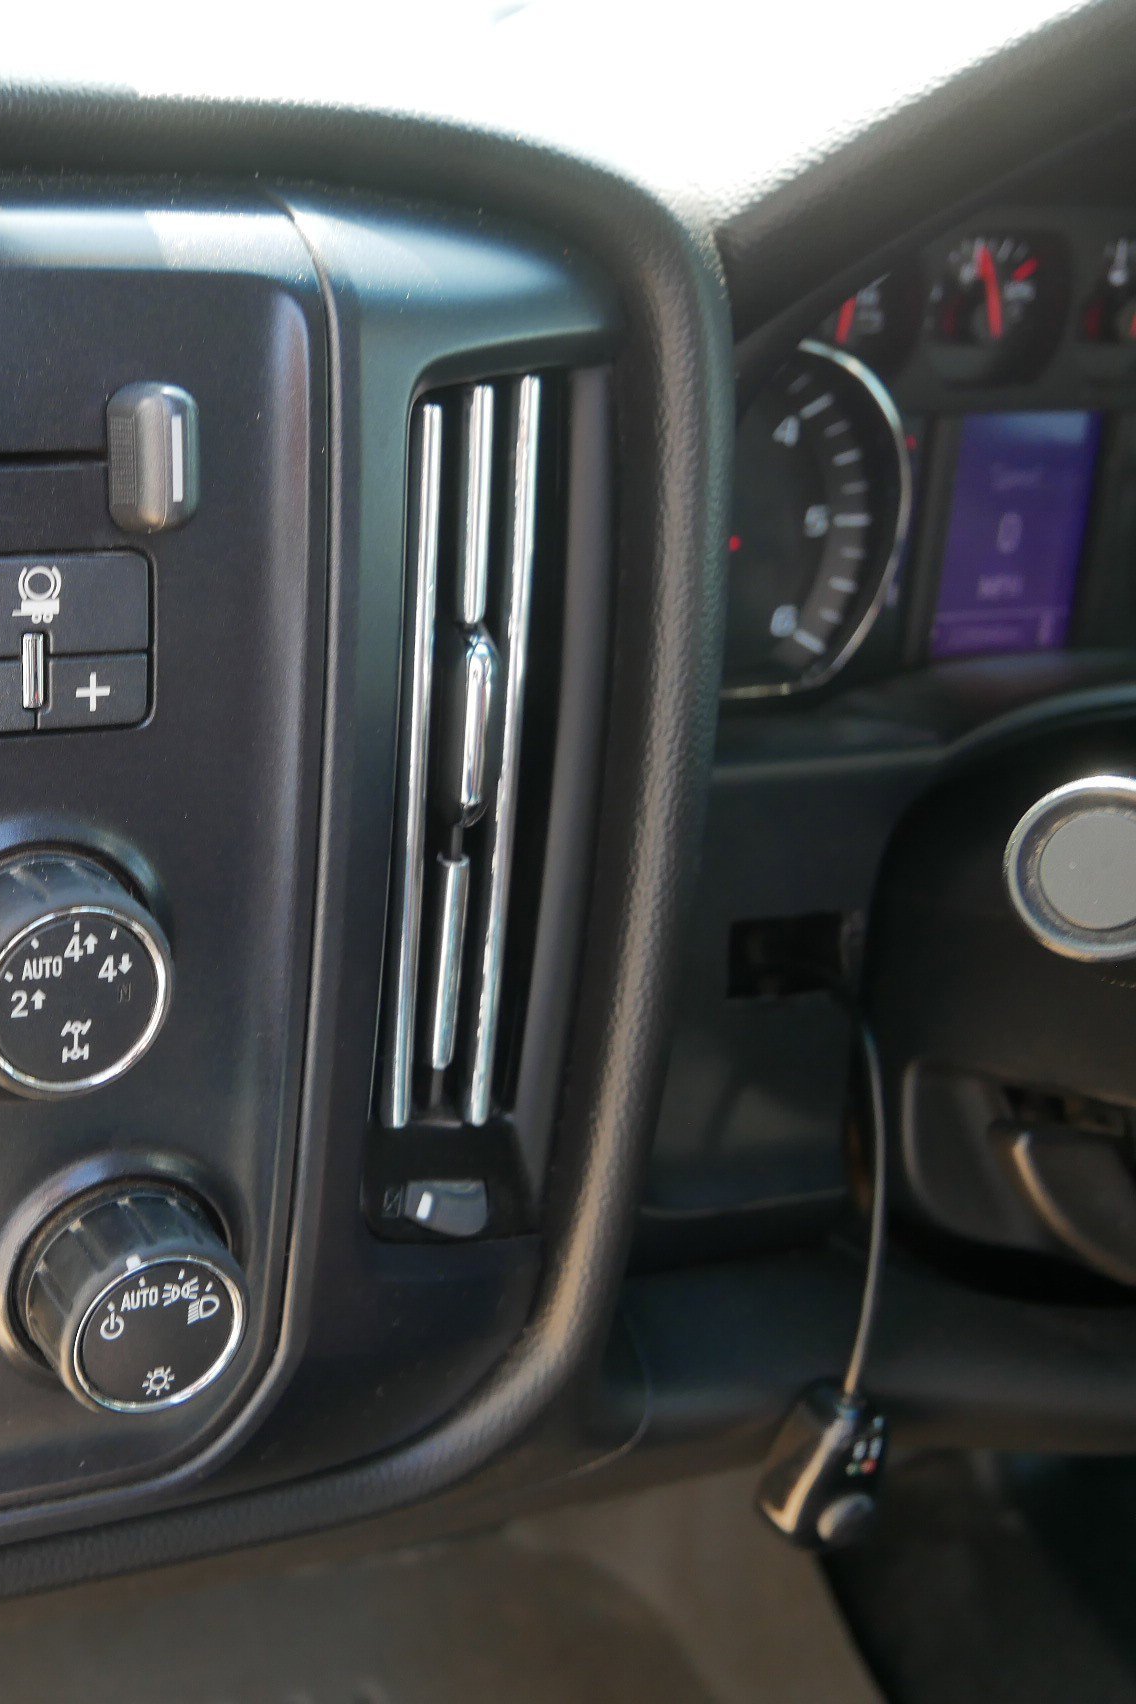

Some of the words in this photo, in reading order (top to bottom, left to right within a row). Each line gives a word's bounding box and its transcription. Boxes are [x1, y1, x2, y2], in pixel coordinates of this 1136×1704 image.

[64, 933, 84, 962] 4
[21, 955, 63, 982] AUTO
[98, 954, 118, 983] 4
[10, 990, 29, 1019] 2
[120, 1284, 159, 1312] AUTO
